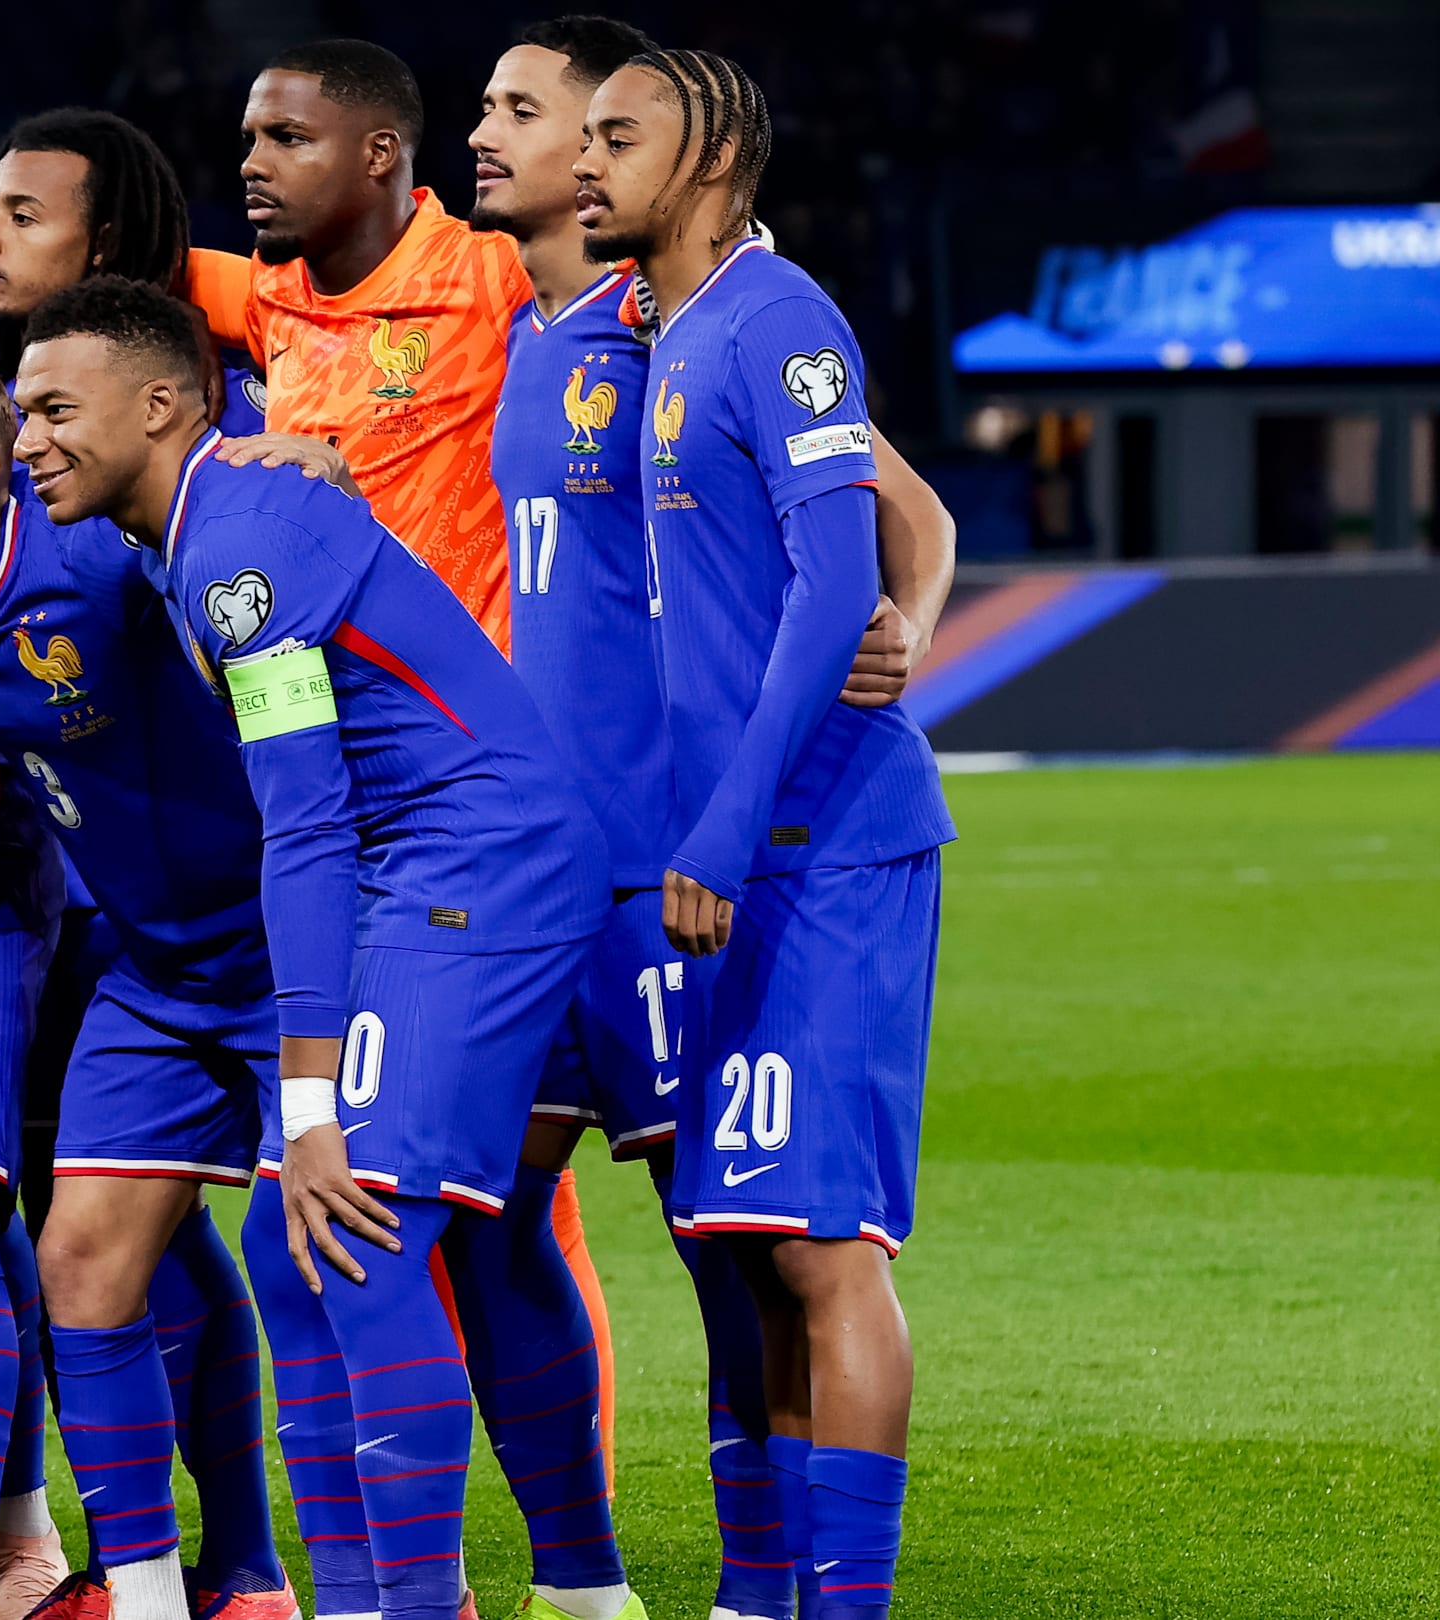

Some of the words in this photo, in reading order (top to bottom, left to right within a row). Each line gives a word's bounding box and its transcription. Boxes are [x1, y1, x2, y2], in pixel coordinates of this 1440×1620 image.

[791, 435, 850, 454] FOUNDATION
[515, 496, 559, 594] 17
[234, 692, 268, 712] SPECT
[23, 751, 82, 829] 3
[341, 1010, 386, 1109] 0
[714, 1052, 792, 1151] 20
